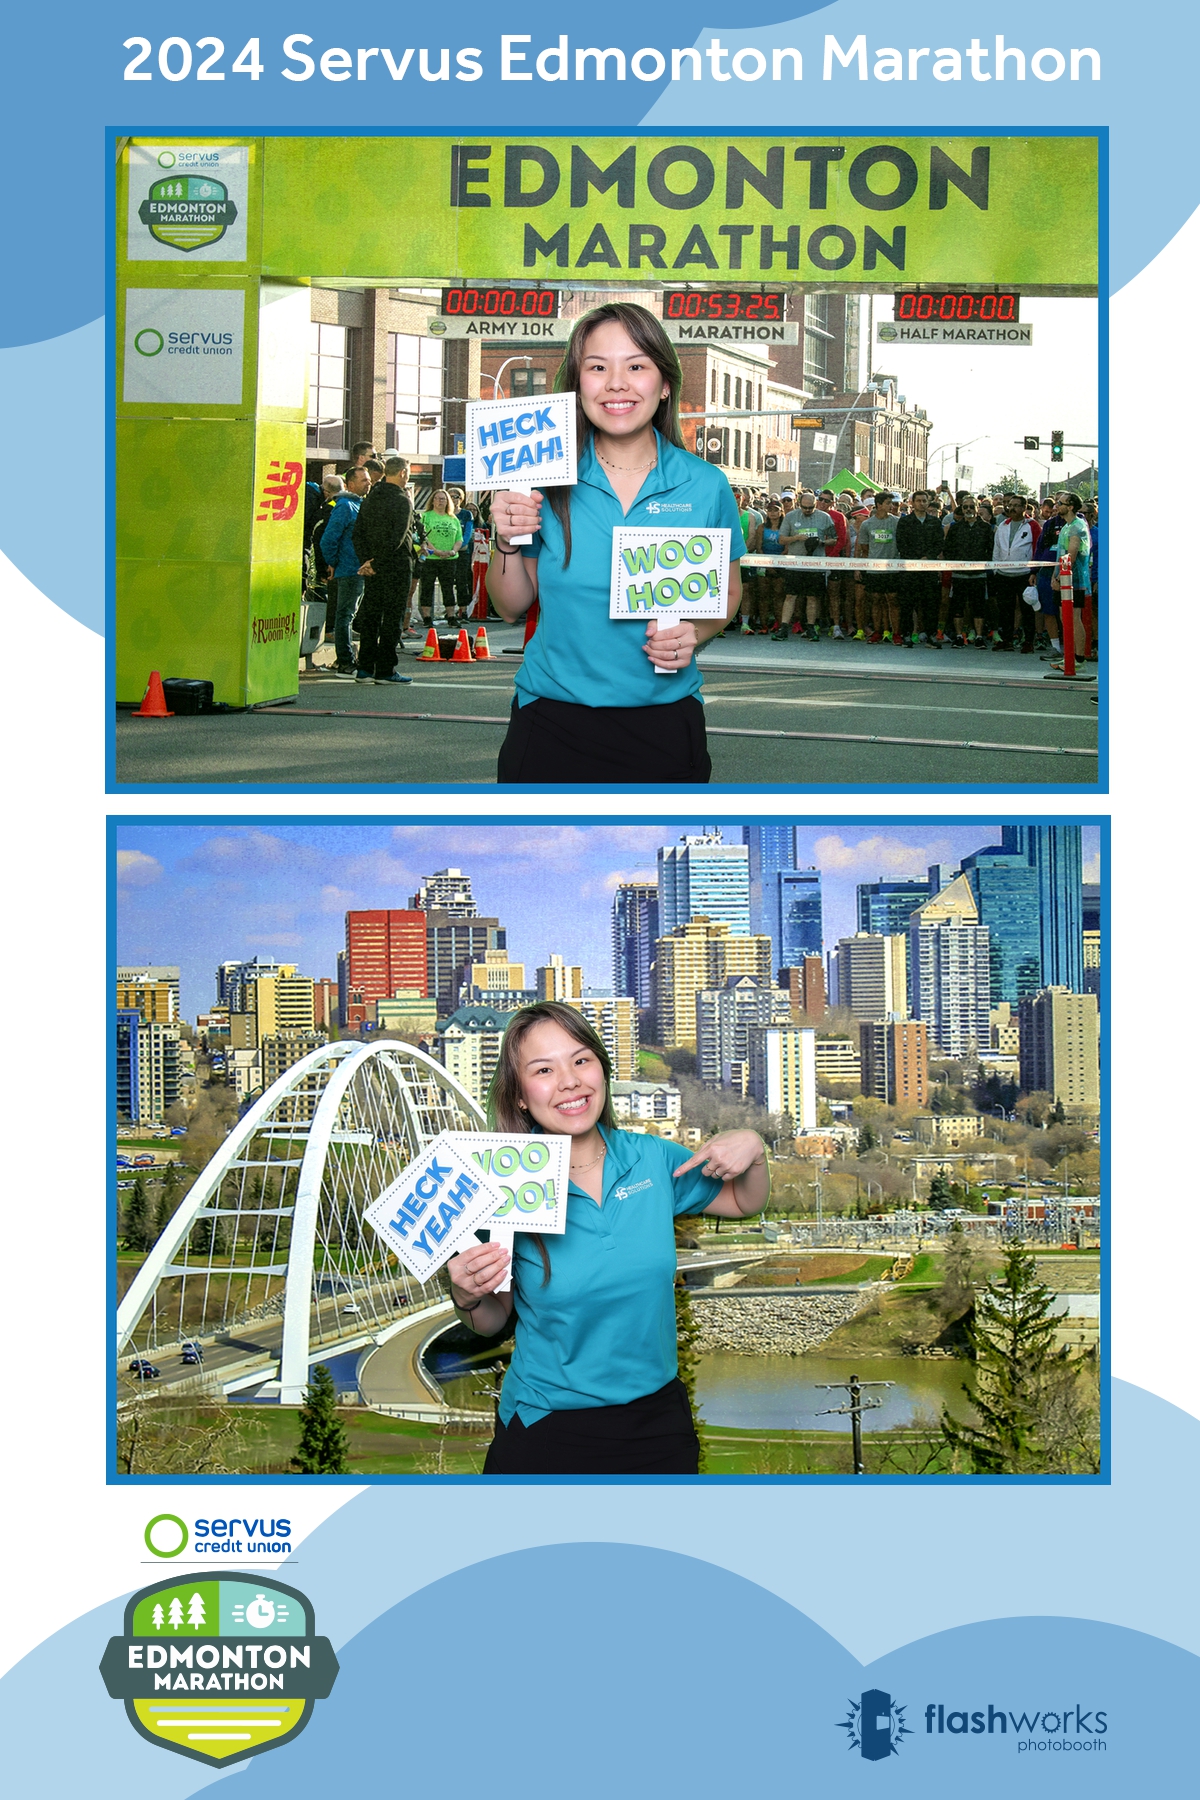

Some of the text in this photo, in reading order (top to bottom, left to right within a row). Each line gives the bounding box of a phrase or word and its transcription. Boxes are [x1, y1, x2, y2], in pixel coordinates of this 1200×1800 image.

[178, 152, 220, 161] servus
[450, 144, 991, 211] EDMONTON
[149, 202, 227, 214] EDMONTON
[160, 213, 216, 223] MARATHON
[523, 222, 907, 271] MARATHON
[168, 332, 233, 345] servus
[465, 321, 555, 336] ARMY 10K
[678, 325, 785, 340] MARATHON
[900, 328, 1031, 341] HALF MARATHON
[168, 345, 233, 355] credit union
[477, 406, 557, 450] HECK
[480, 435, 564, 480] YEAH!
[621, 535, 712, 576] WOO
[626, 569, 720, 613] HOO!
[389, 1156, 454, 1241] HECK
[412, 1172, 480, 1260] YEAH!
